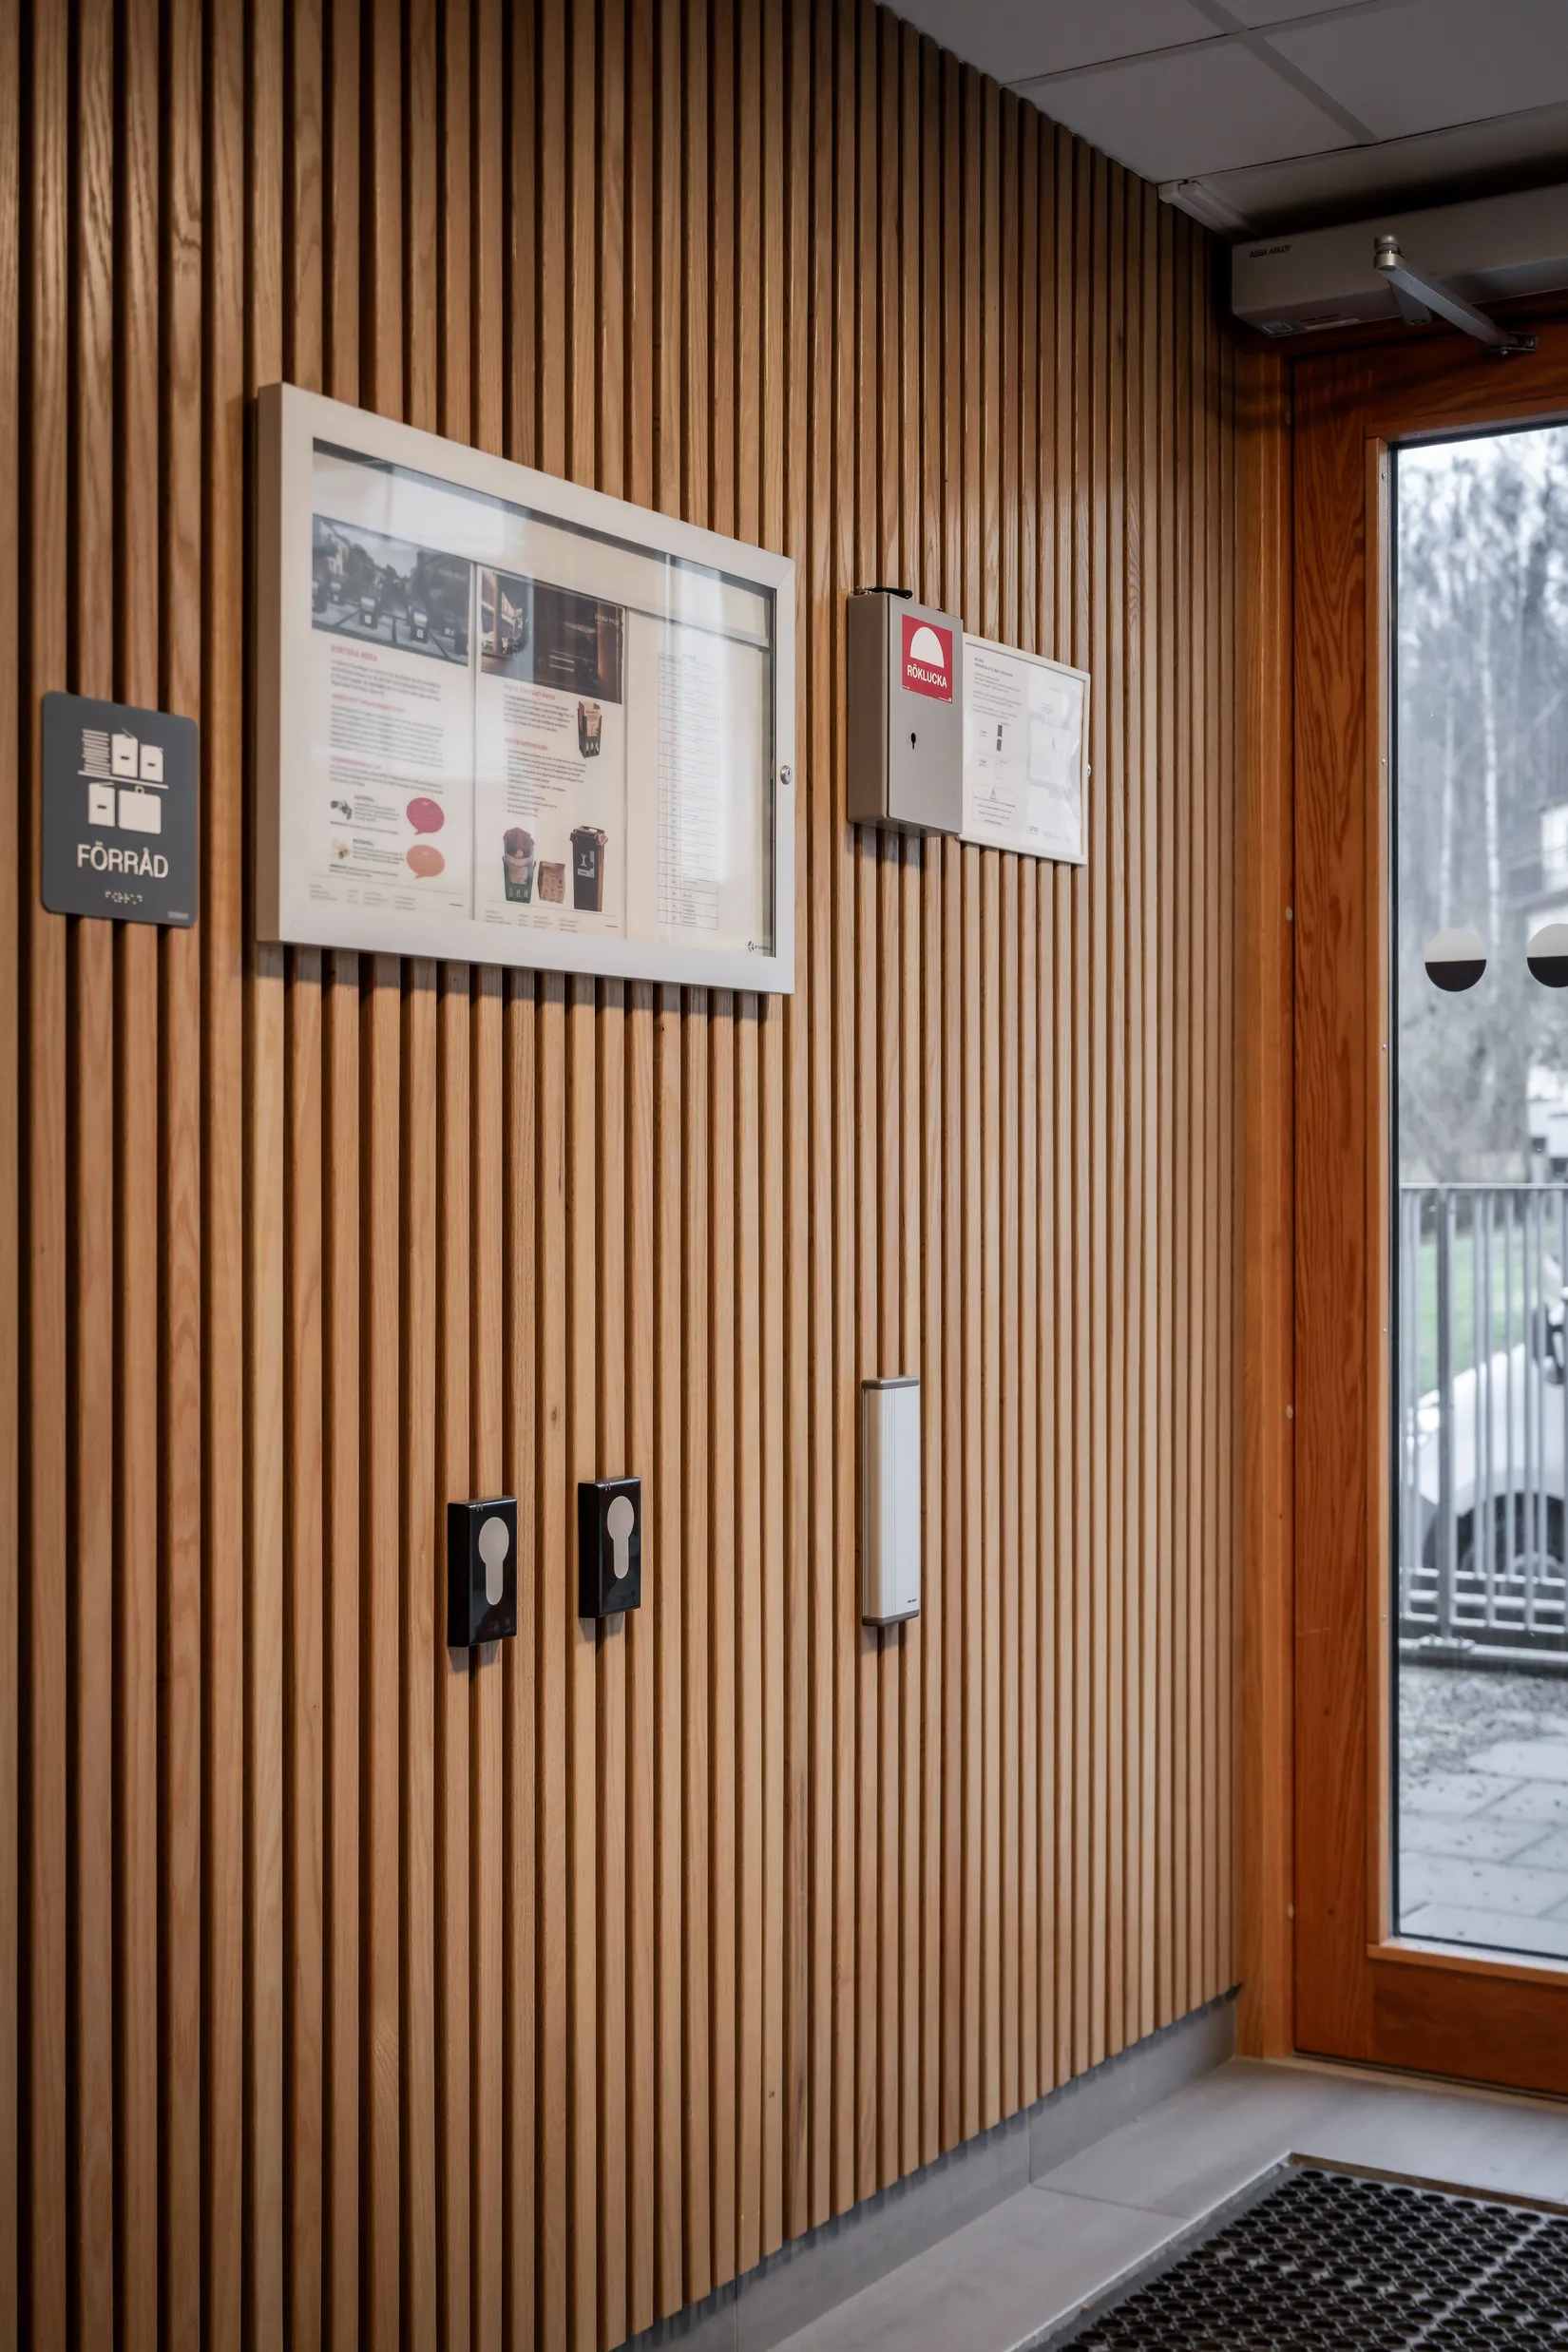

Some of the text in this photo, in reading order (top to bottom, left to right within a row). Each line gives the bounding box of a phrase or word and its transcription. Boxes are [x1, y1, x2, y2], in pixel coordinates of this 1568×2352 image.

[1249, 243, 1291, 258] ASSA ABLOY
[907, 663, 947, 689] RÖKLUCKA
[76, 840, 169, 879] FÖRRÅD
